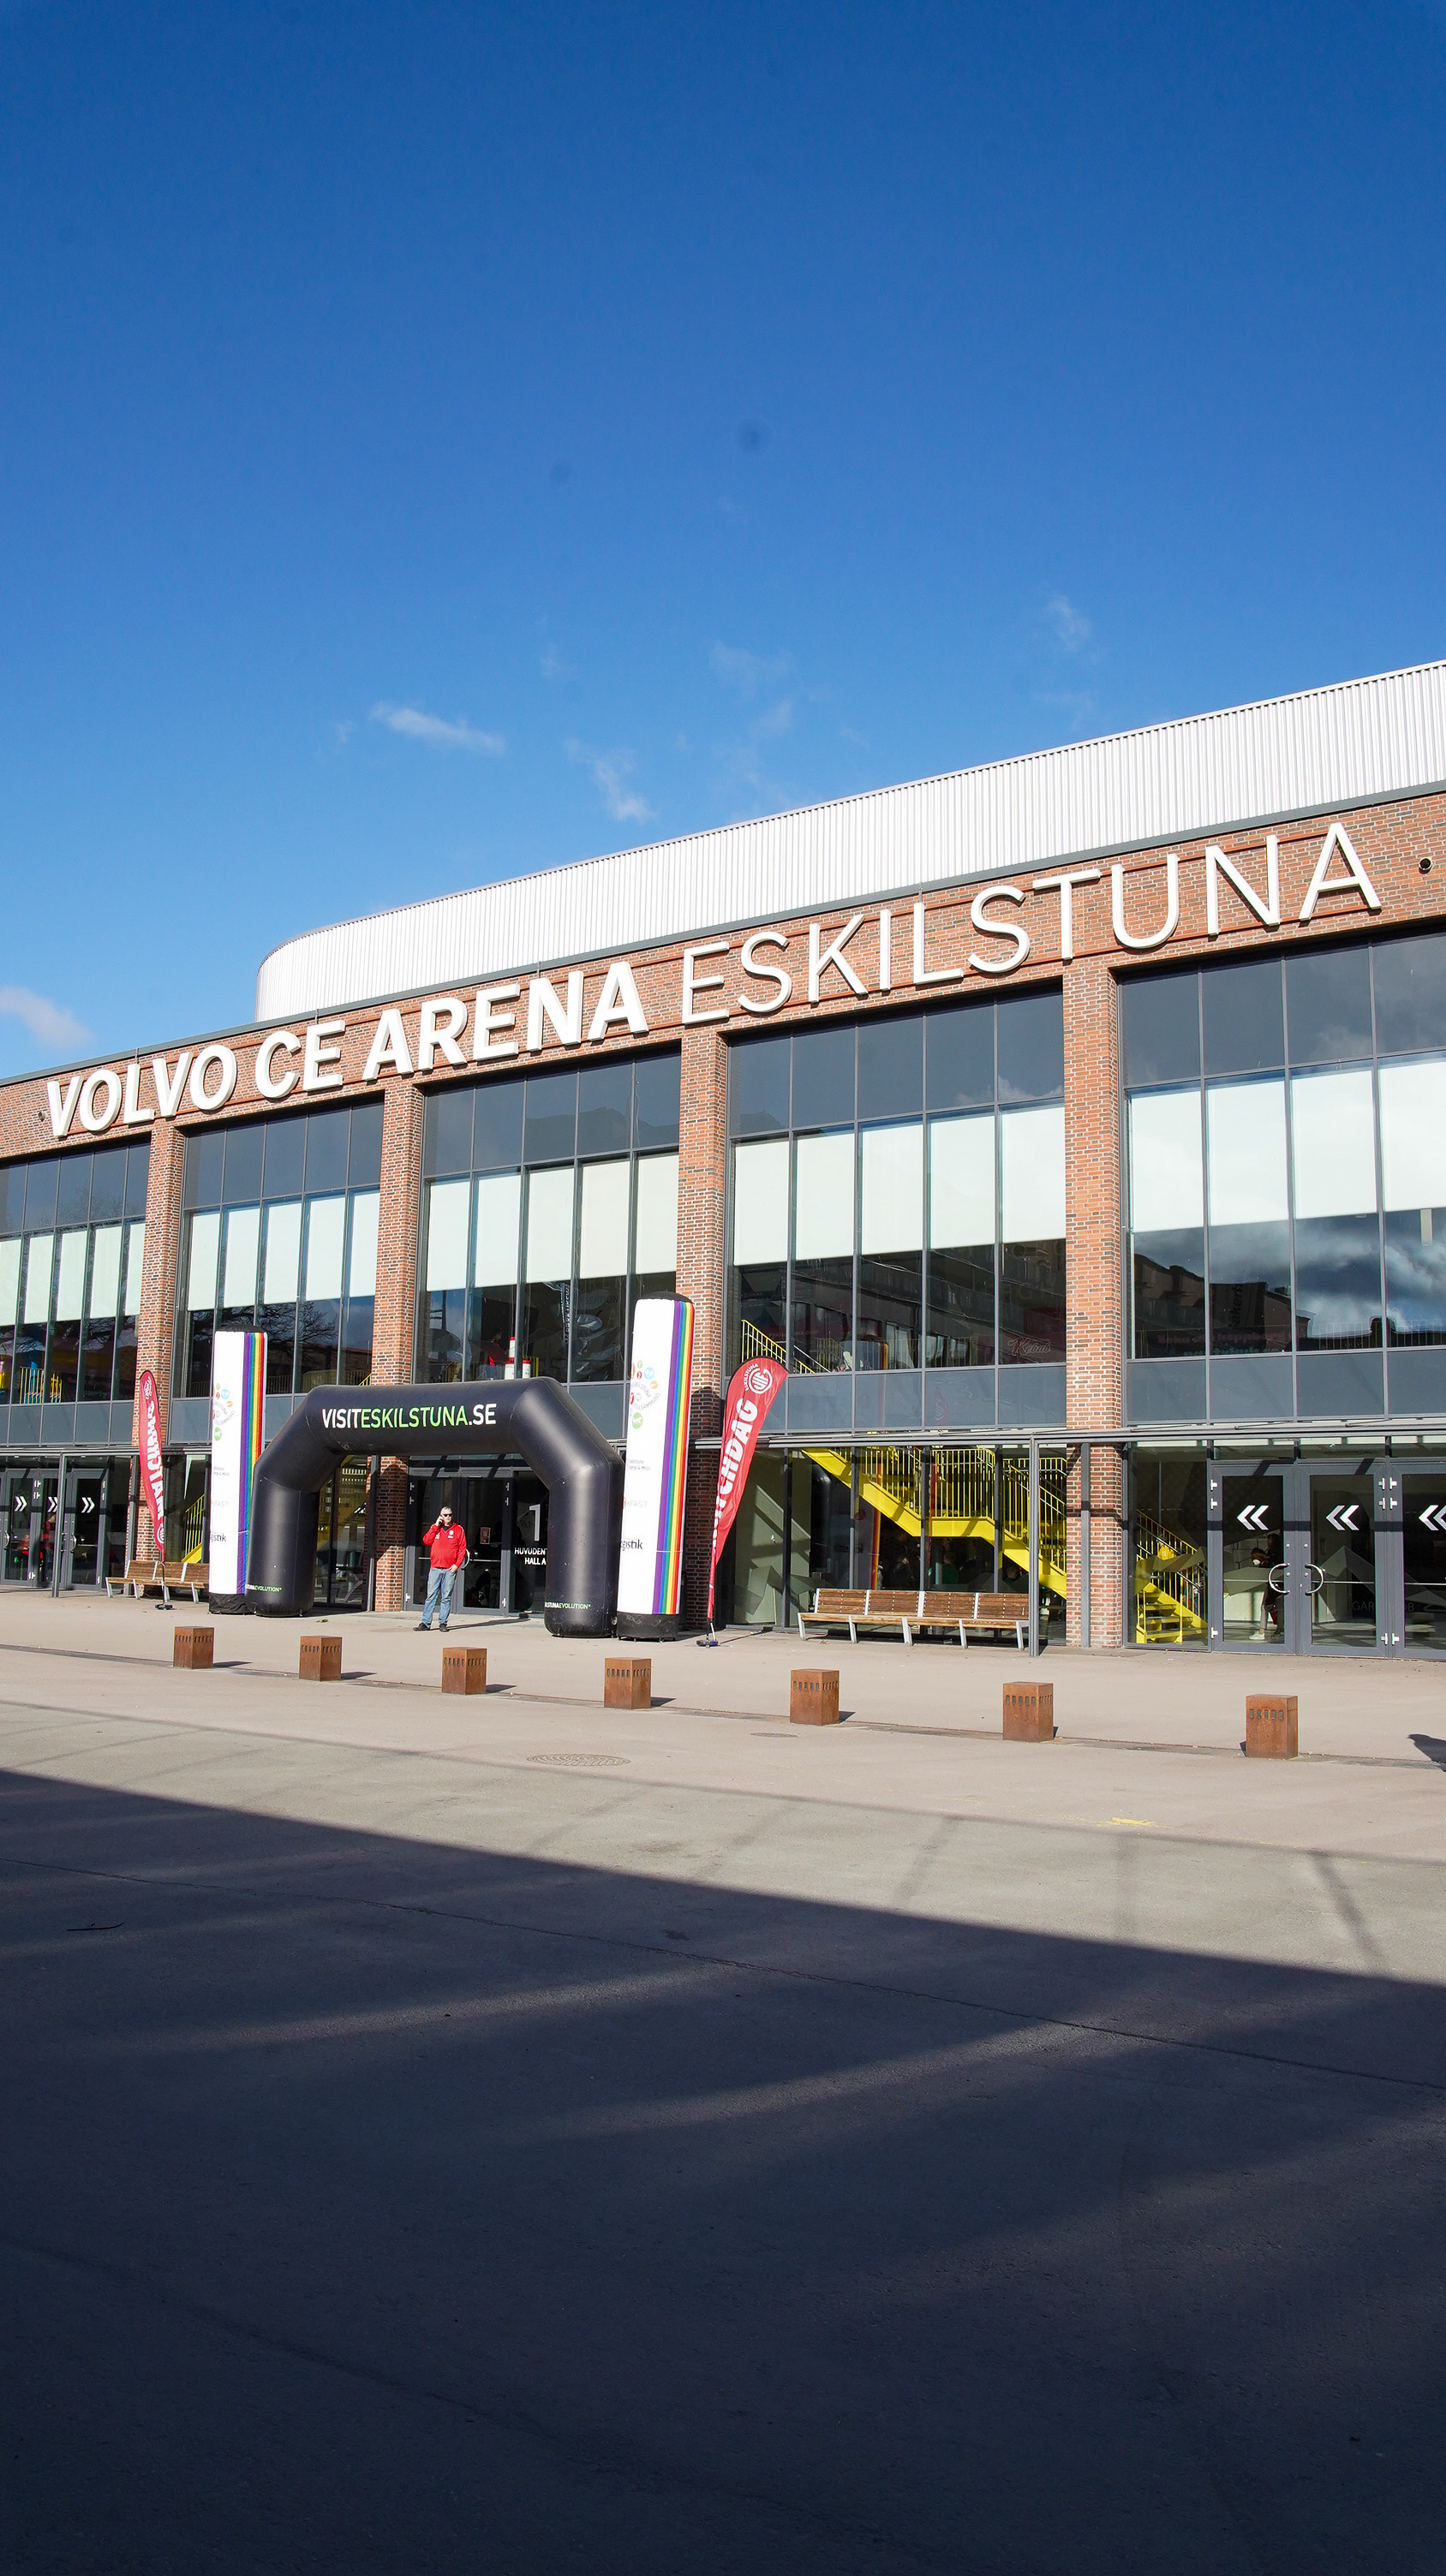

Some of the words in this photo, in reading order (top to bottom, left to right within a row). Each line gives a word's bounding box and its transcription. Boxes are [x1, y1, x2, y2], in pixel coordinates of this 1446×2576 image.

[46, 1044, 237, 1138] VOLVO
[255, 1019, 346, 1100] CE
[362, 961, 649, 1082] ARENA
[682, 822, 1382, 1024] ESKILSTUNA
[321, 1404, 497, 1428] VISITESKILSTUNA.SE
[529, 1504, 541, 1541] 1
